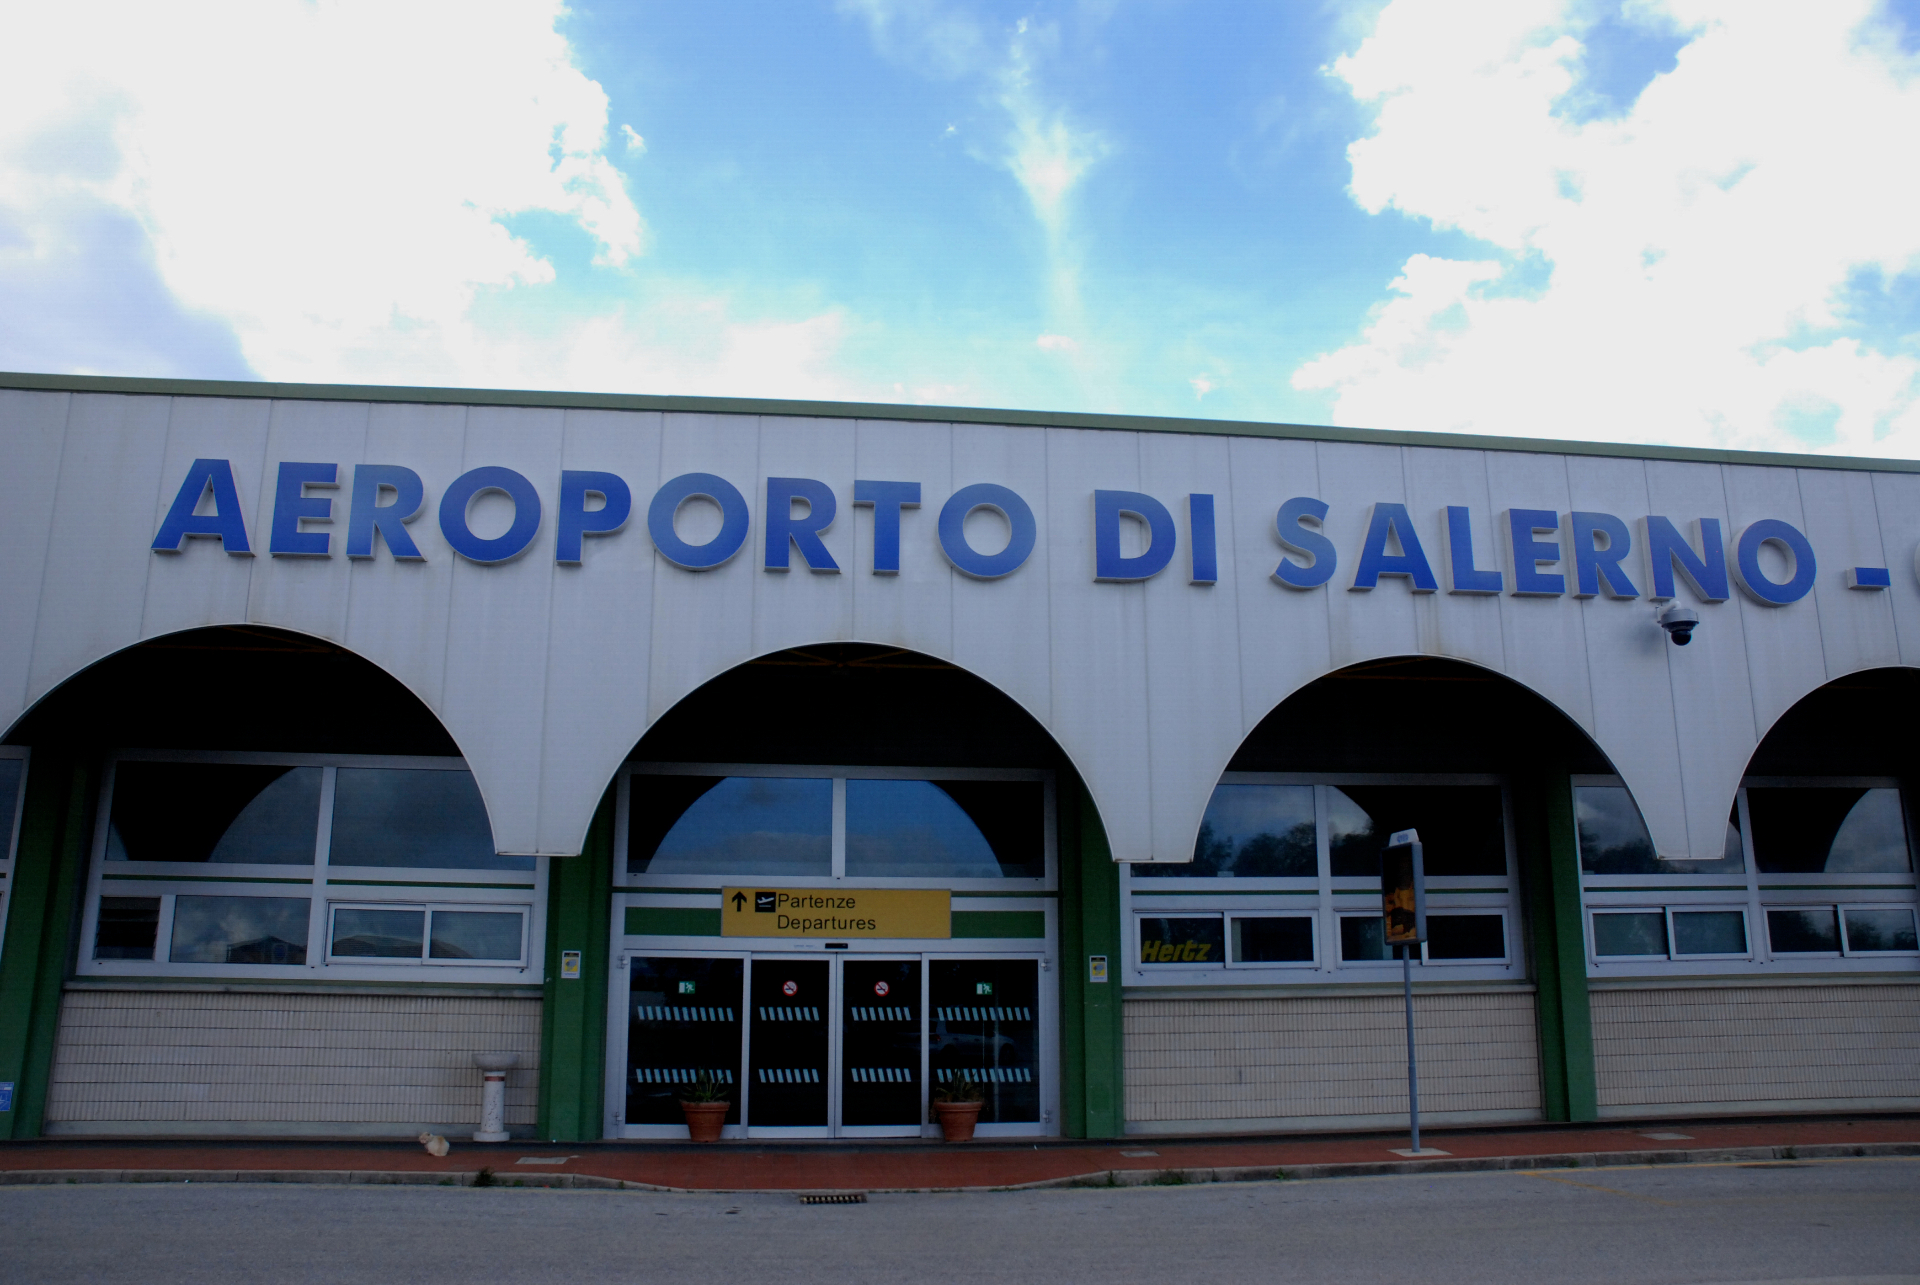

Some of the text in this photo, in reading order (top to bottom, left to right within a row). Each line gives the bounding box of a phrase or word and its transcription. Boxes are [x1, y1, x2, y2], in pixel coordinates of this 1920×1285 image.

[152, 459, 1037, 579] AEROPORTO
[1095, 490, 1219, 583] DI
[1274, 497, 1817, 605] SALERNO
[778, 893, 856, 908] Partenze
[777, 915, 876, 932] Departures
[1141, 940, 1211, 962] Hertz
